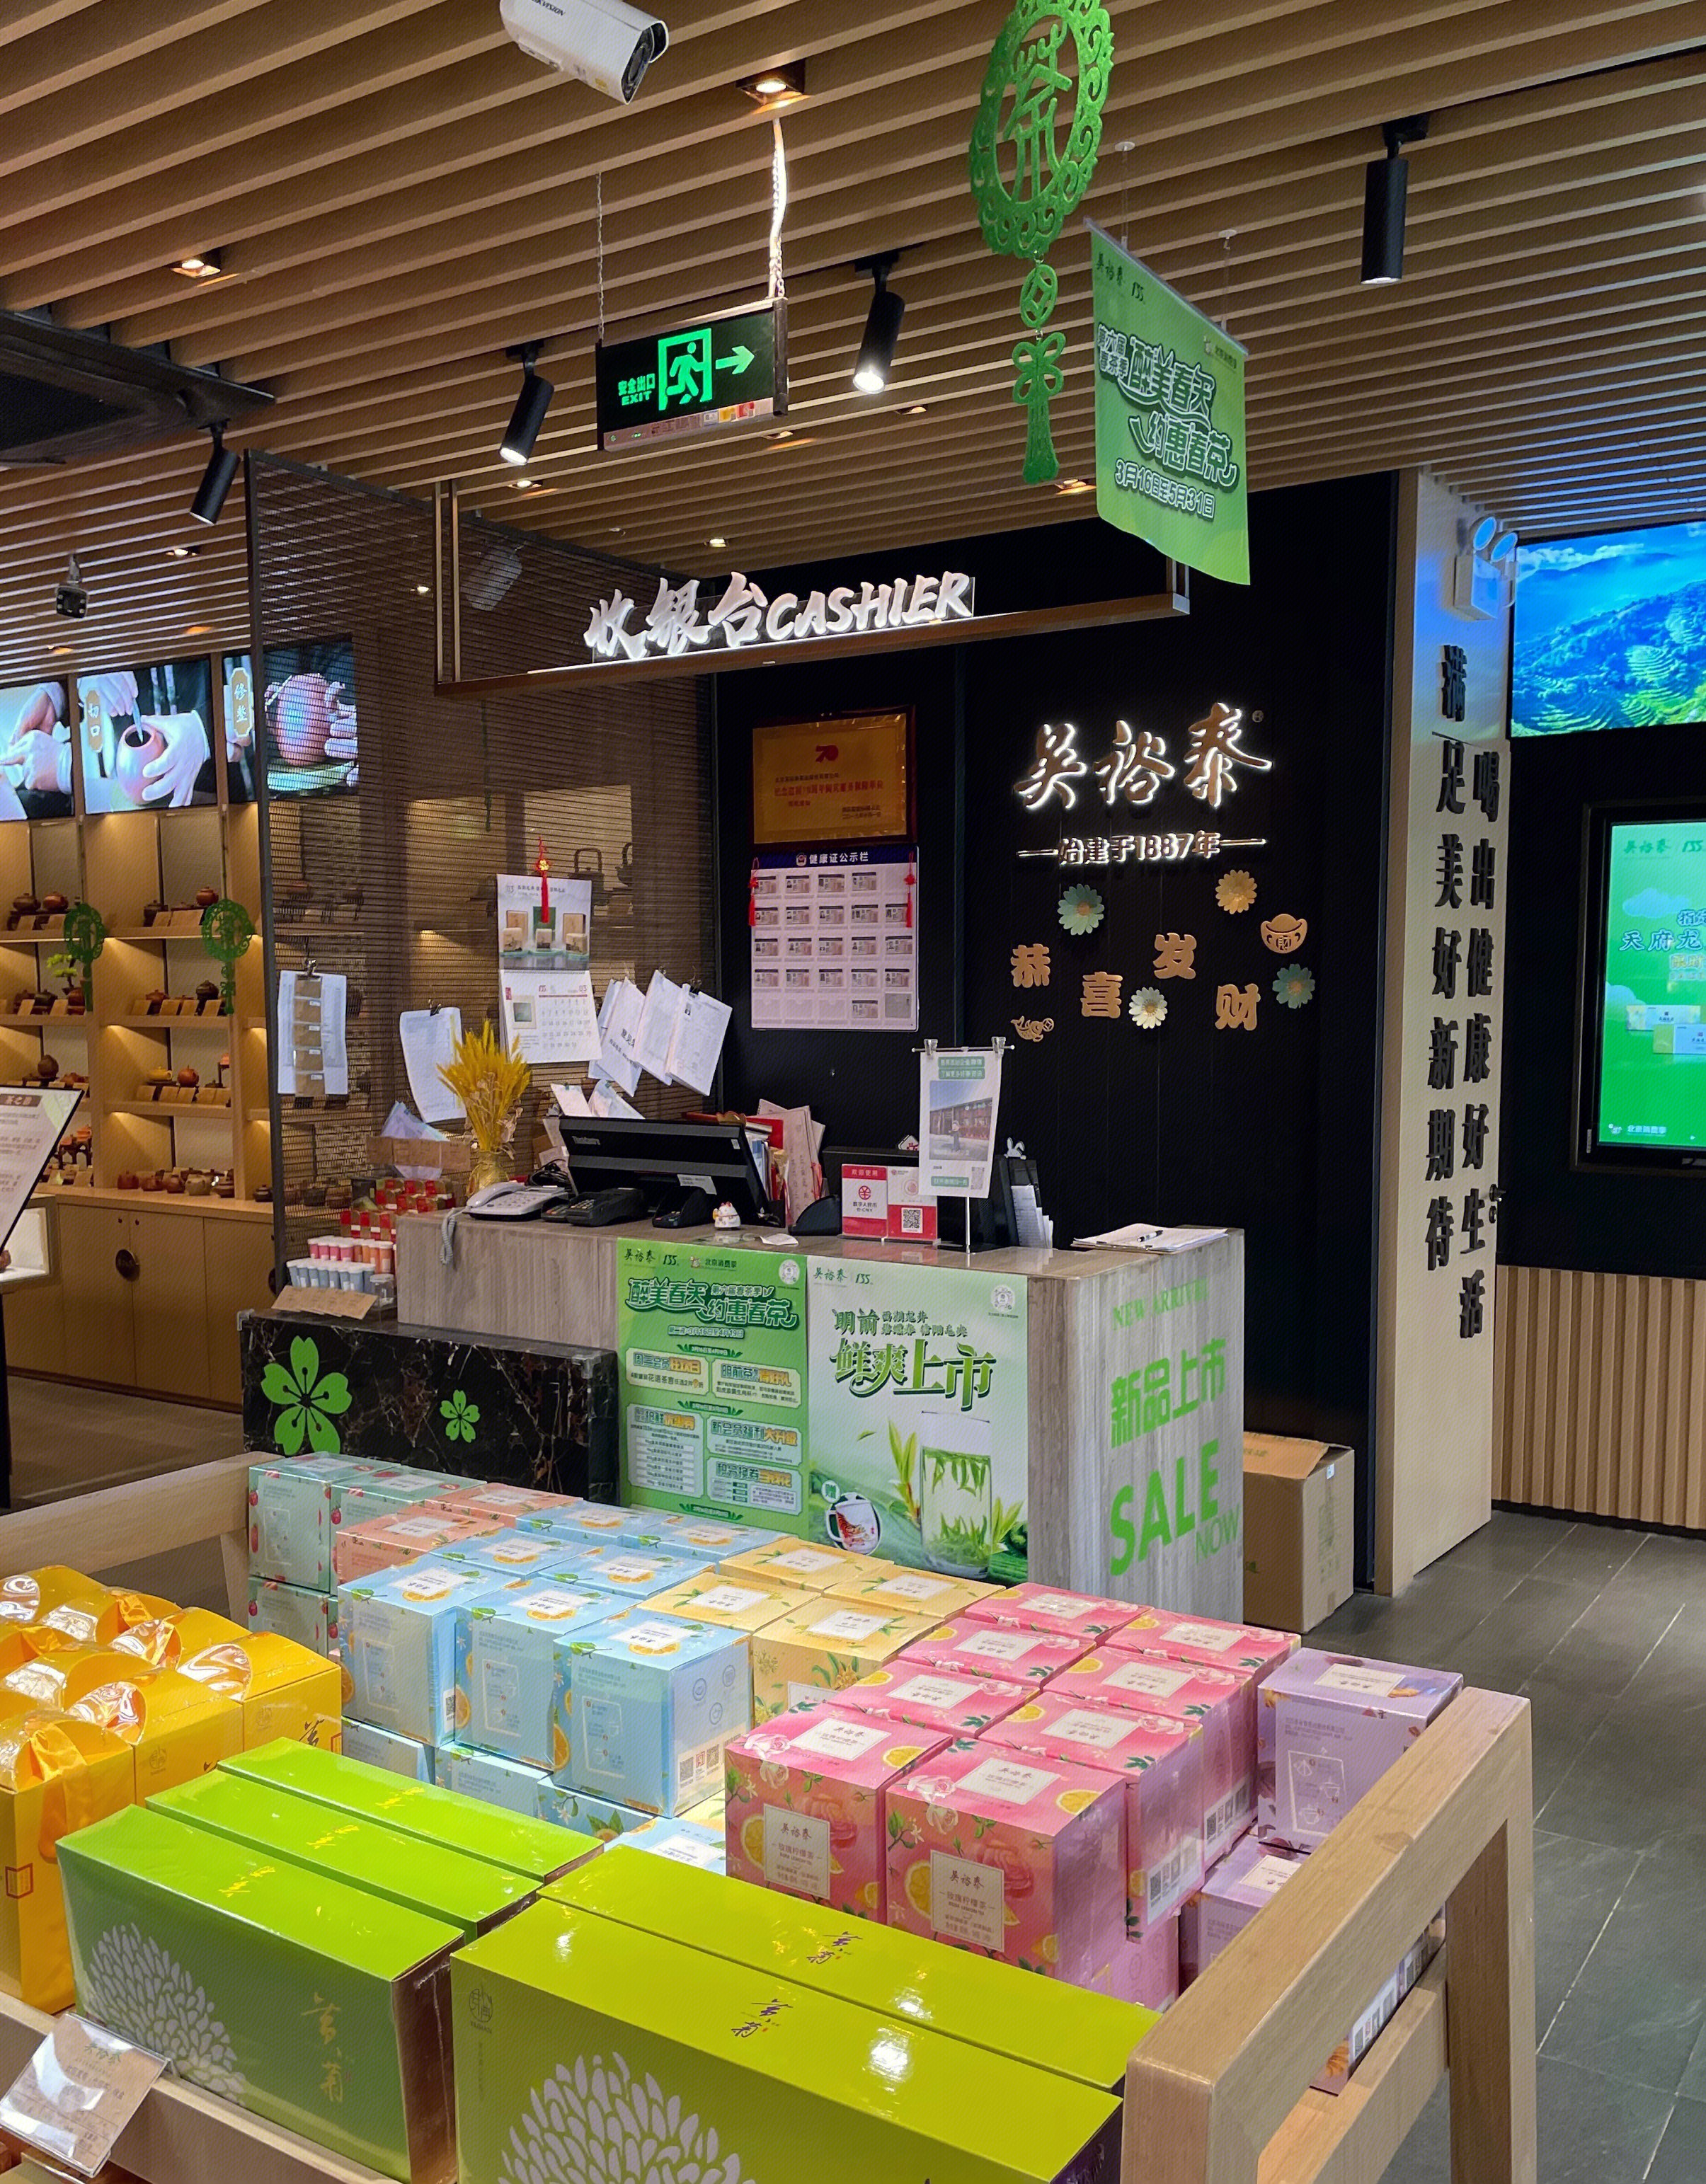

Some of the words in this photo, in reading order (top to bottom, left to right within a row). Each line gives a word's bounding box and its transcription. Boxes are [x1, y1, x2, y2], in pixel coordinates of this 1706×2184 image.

[618, 373, 655, 396] 安全出口
[1118, 335, 1216, 425] 醉美春天
[622, 391, 652, 406] EXIT
[1129, 410, 1238, 488] 约惠春茶
[1115, 458, 1216, 519] 3月16日至5月31日
[583, 571, 768, 660] 收银台
[767, 571, 973, 640] CASHIER
[1012, 702, 1273, 810] 吴裕泰
[809, 851, 869, 864] 健康证公示栏
[1059, 830, 1221, 866] 始建于1887年
[1426, 644, 1467, 1271] 满足美好新期待
[1460, 750, 1501, 1339] 喝出健康好生活
[624, 1248, 656, 1264] 吴裕泰
[663, 1255, 678, 1265] 135
[711, 1283, 763, 1297] 第六届春茶季
[813, 1267, 848, 1282] 吴裕泰
[855, 1272, 871, 1284] 135
[625, 1277, 708, 1312] 醉美春天
[696, 1297, 798, 1328] 约惠春茶
[831, 1308, 879, 1337] 明前
[882, 1310, 928, 1323] 西湖龙井
[1114, 1302, 1145, 1330] NEW
[920, 1323, 968, 1337] 信阳毛尖
[830, 1338, 997, 1412] 鲜爽上市
[1111, 1338, 1227, 1449] 新品上市
[1109, 1438, 1219, 1576] SALE
[1196, 1502, 1240, 1564] NOW
[781, 1822, 812, 1841] 吴裕泰
[950, 1869, 984, 1890] 吴裕泰
